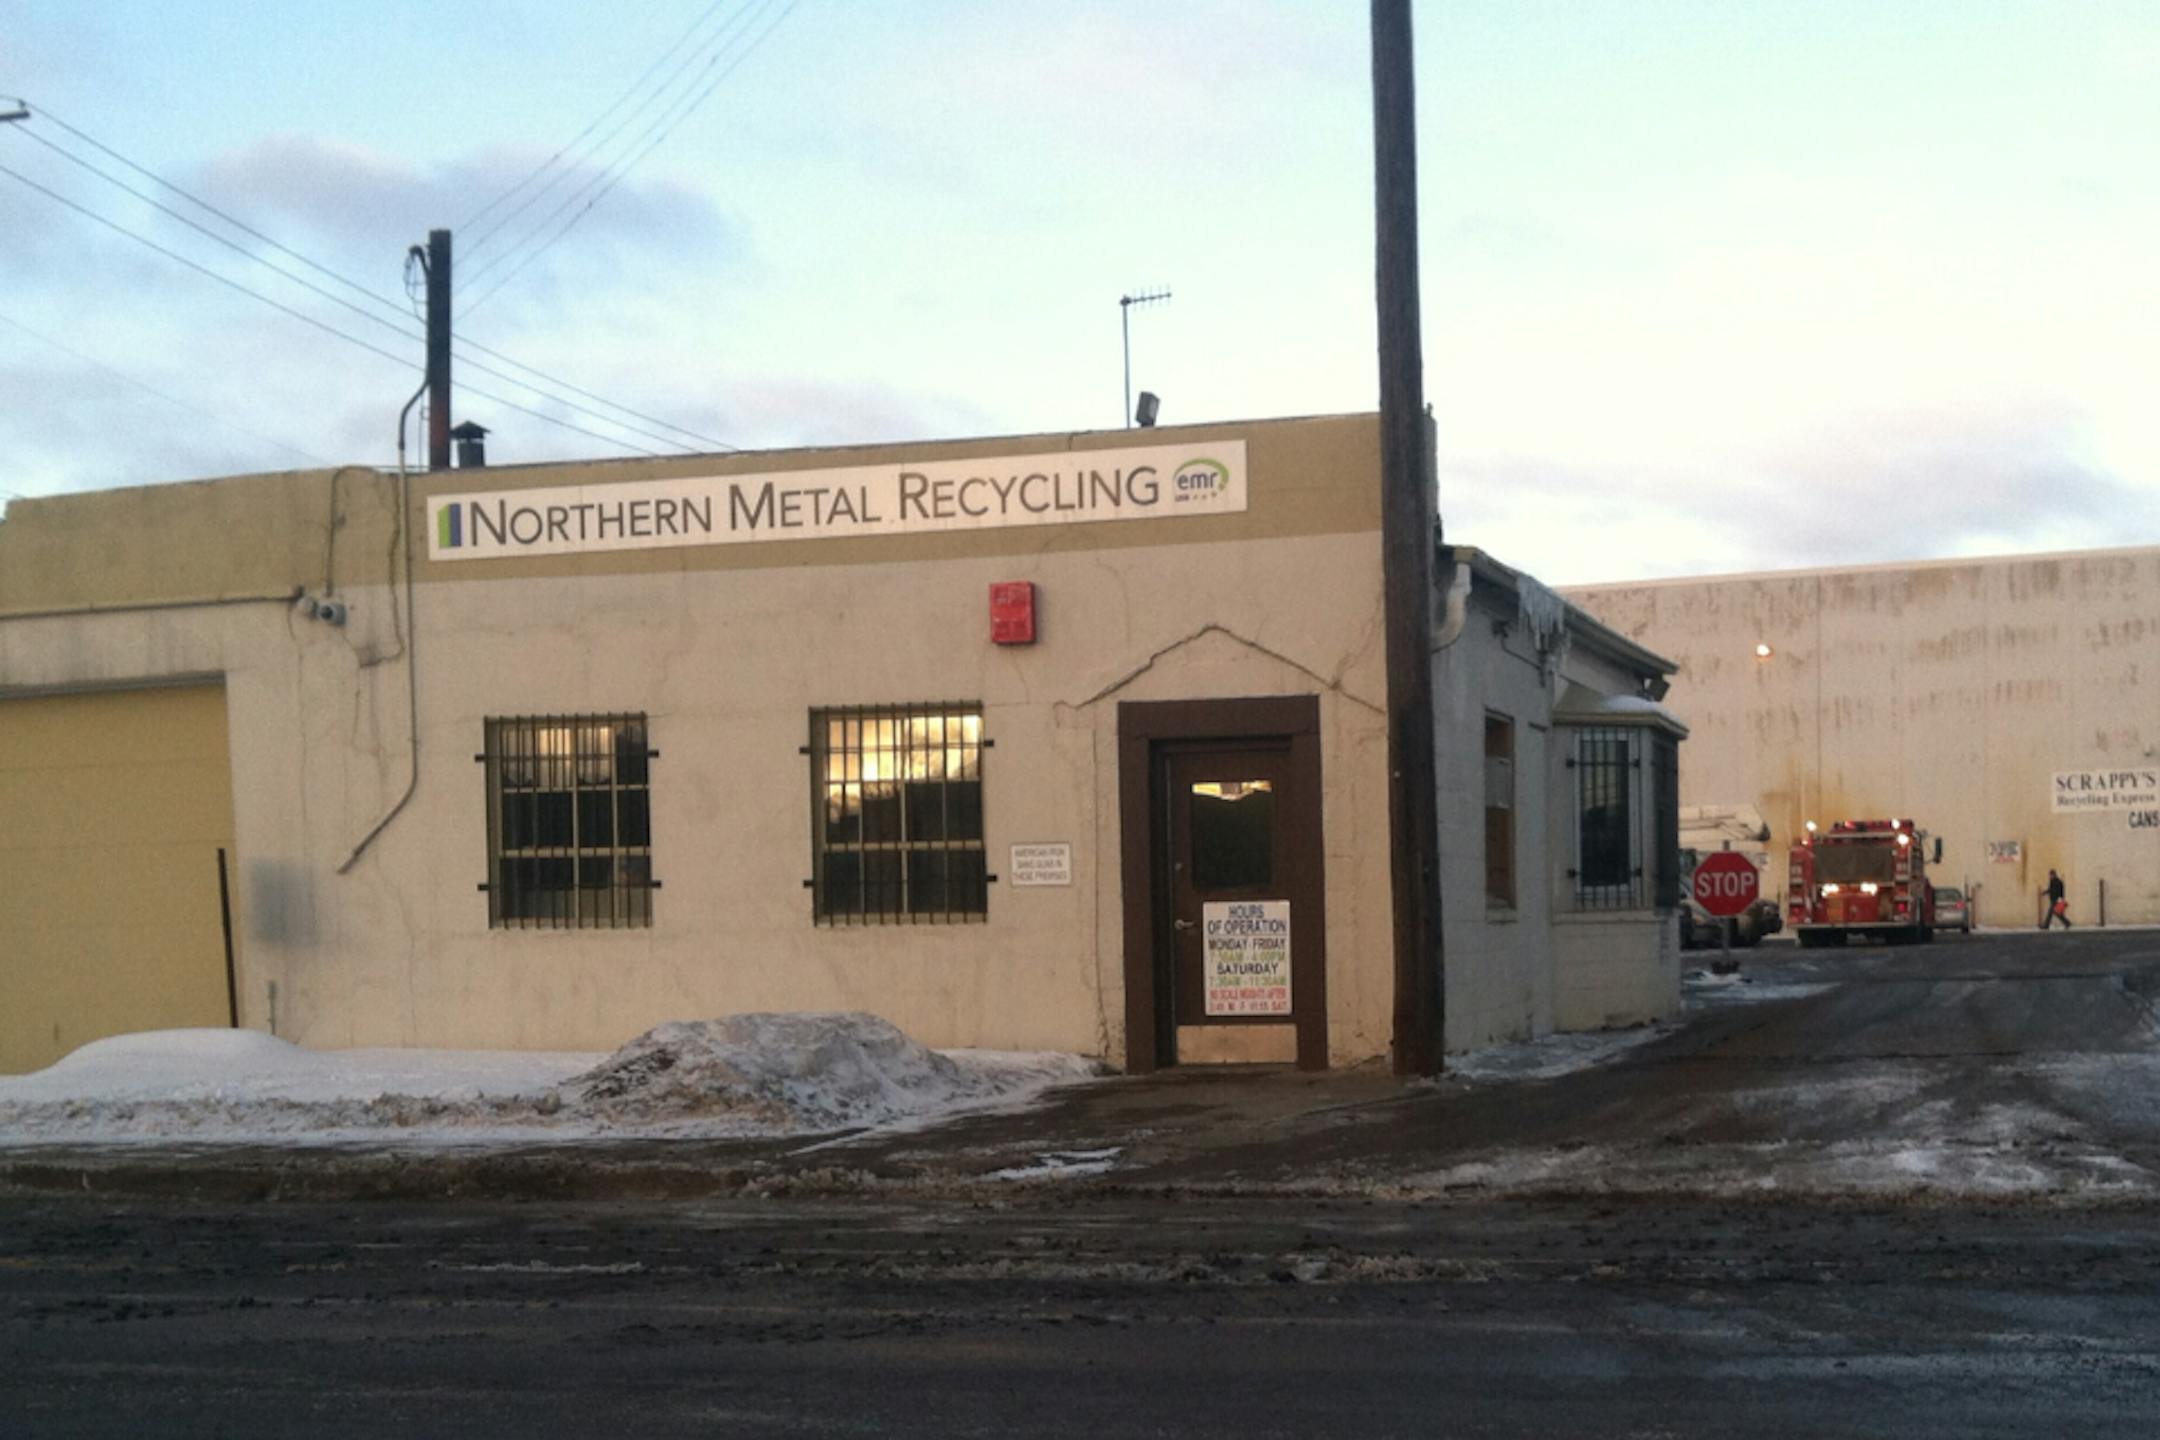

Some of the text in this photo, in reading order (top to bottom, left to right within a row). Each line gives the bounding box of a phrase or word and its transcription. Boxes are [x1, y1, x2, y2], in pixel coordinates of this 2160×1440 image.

[1177, 472, 1218, 490] emr
[470, 466, 1160, 546] NORTHERN METAL RECYCLING
[2056, 772, 2156, 791] SCRAPPY'S
[2057, 792, 2155, 808] Recycling Express
[2129, 811, 2159, 828] CANS
[1699, 872, 1755, 897] STOP
[1228, 904, 1264, 919] HOURS
[1207, 919, 1286, 934] OF OPERATION
[1208, 938, 1285, 950] MONDAY FRIDAY
[1217, 963, 1278, 975] SATURDAY
